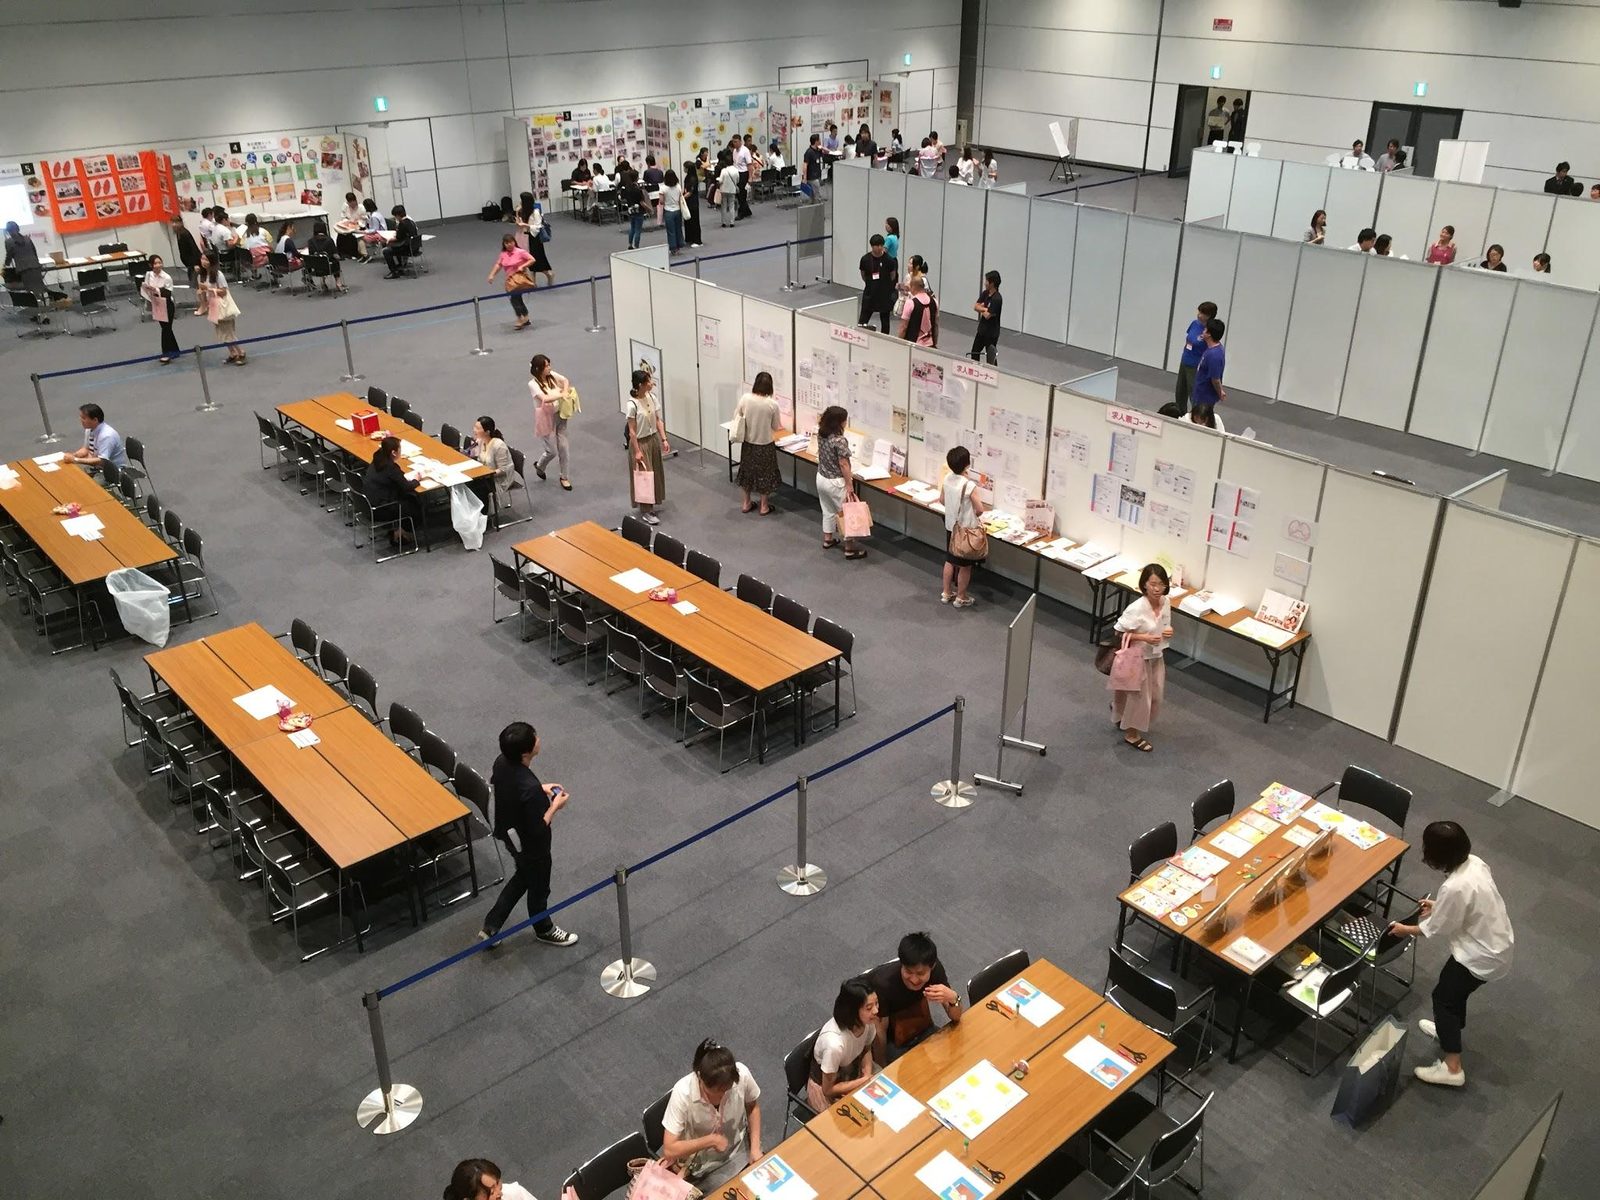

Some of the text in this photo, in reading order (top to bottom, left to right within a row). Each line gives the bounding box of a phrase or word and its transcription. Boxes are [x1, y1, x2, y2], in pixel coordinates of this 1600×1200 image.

[24, 165, 31, 173] 5
[1111, 412, 1157, 429] 求人票コーナー
